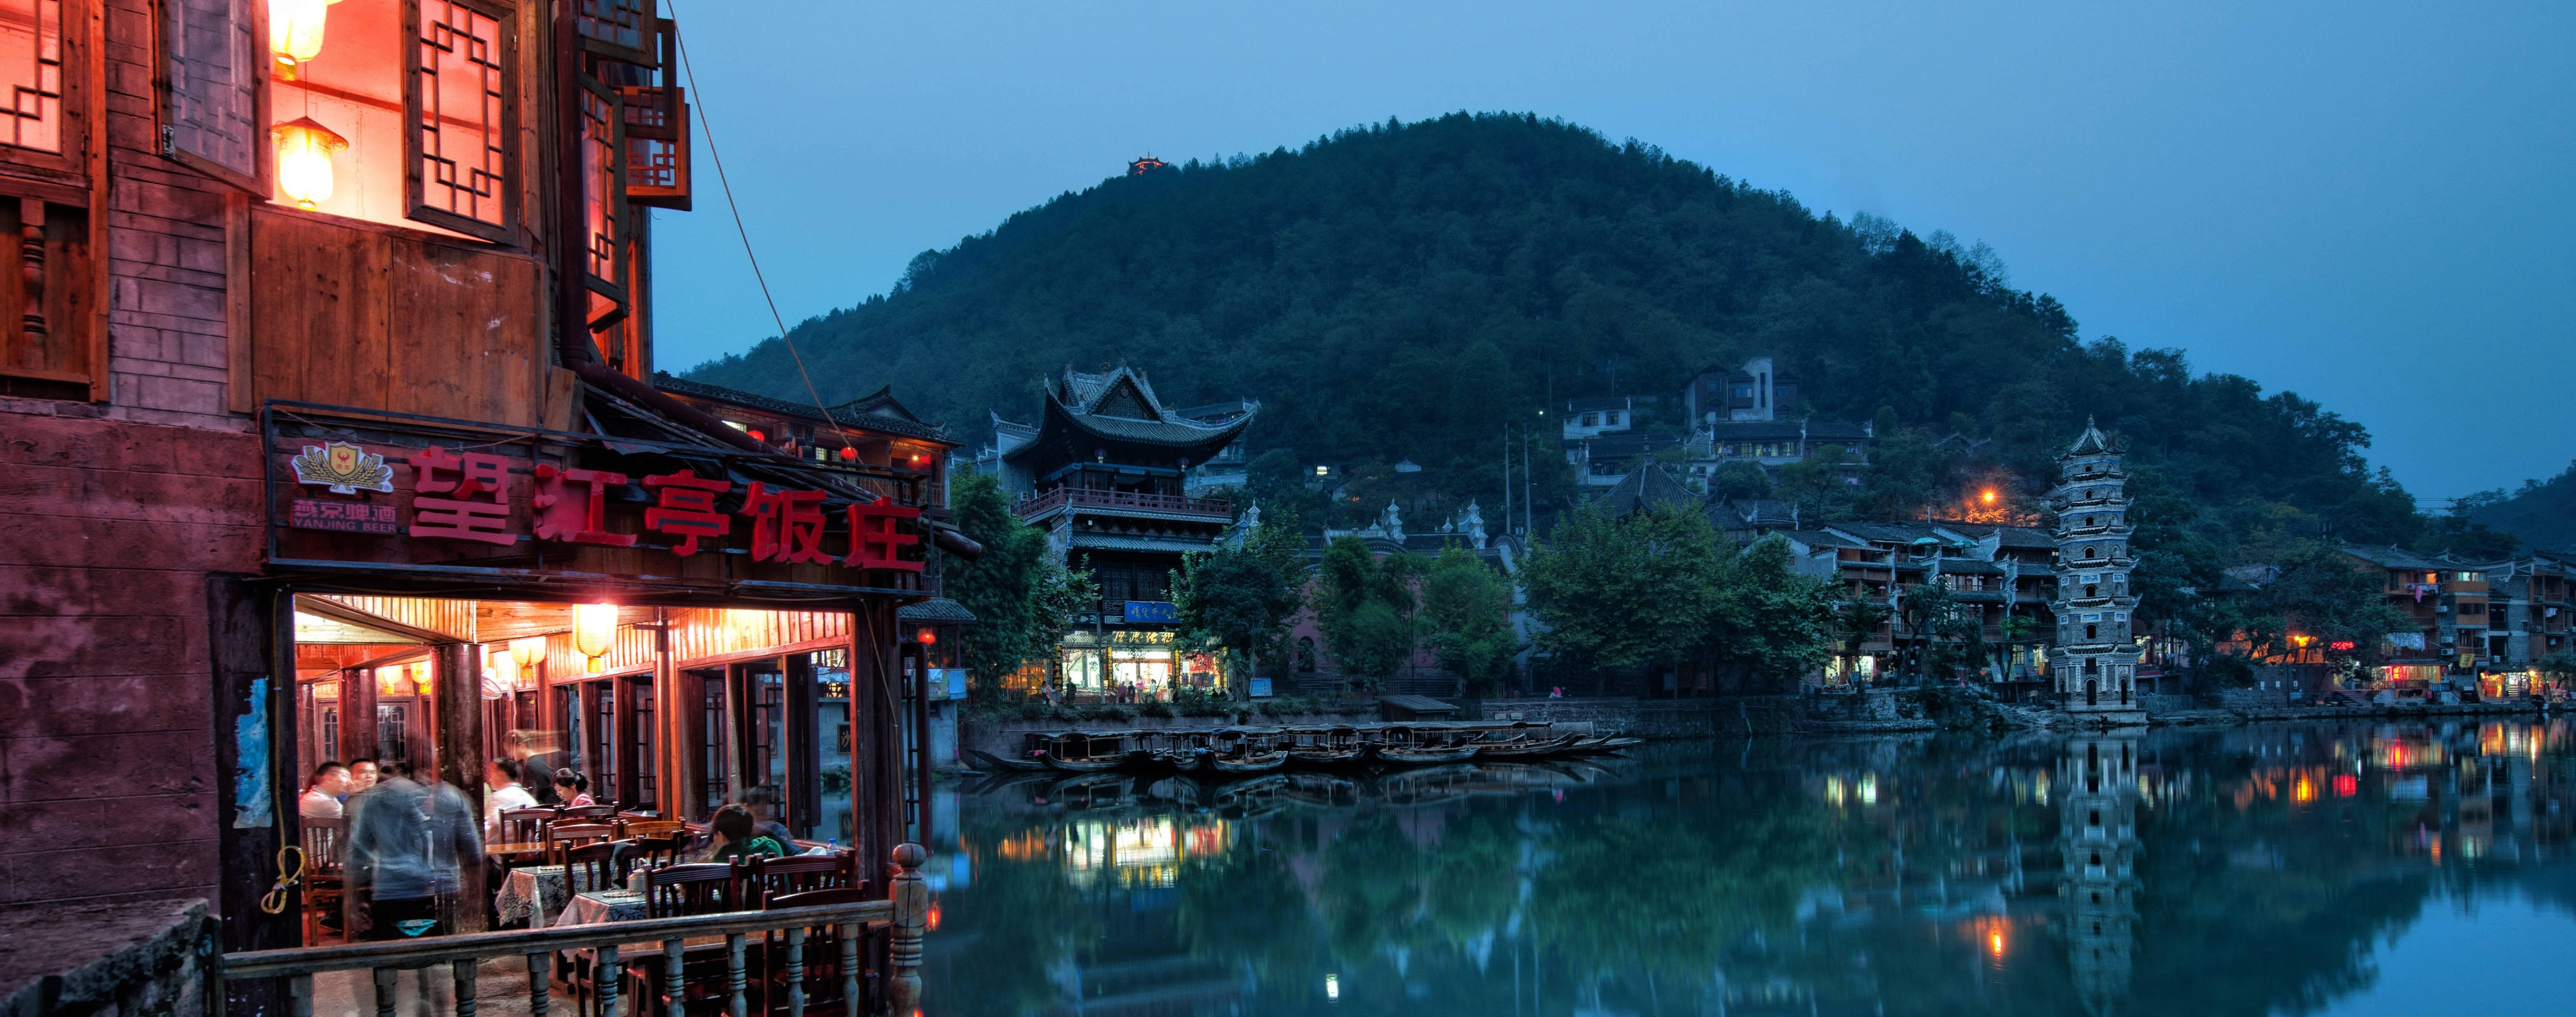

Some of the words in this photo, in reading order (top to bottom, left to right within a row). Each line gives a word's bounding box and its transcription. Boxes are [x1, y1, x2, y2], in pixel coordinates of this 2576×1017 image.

[293, 499, 396, 522] 燕京啤酒
[408, 445, 925, 572] 望江亭饭庄
[294, 518, 356, 531] YANJING
[363, 522, 396, 532] BEER
